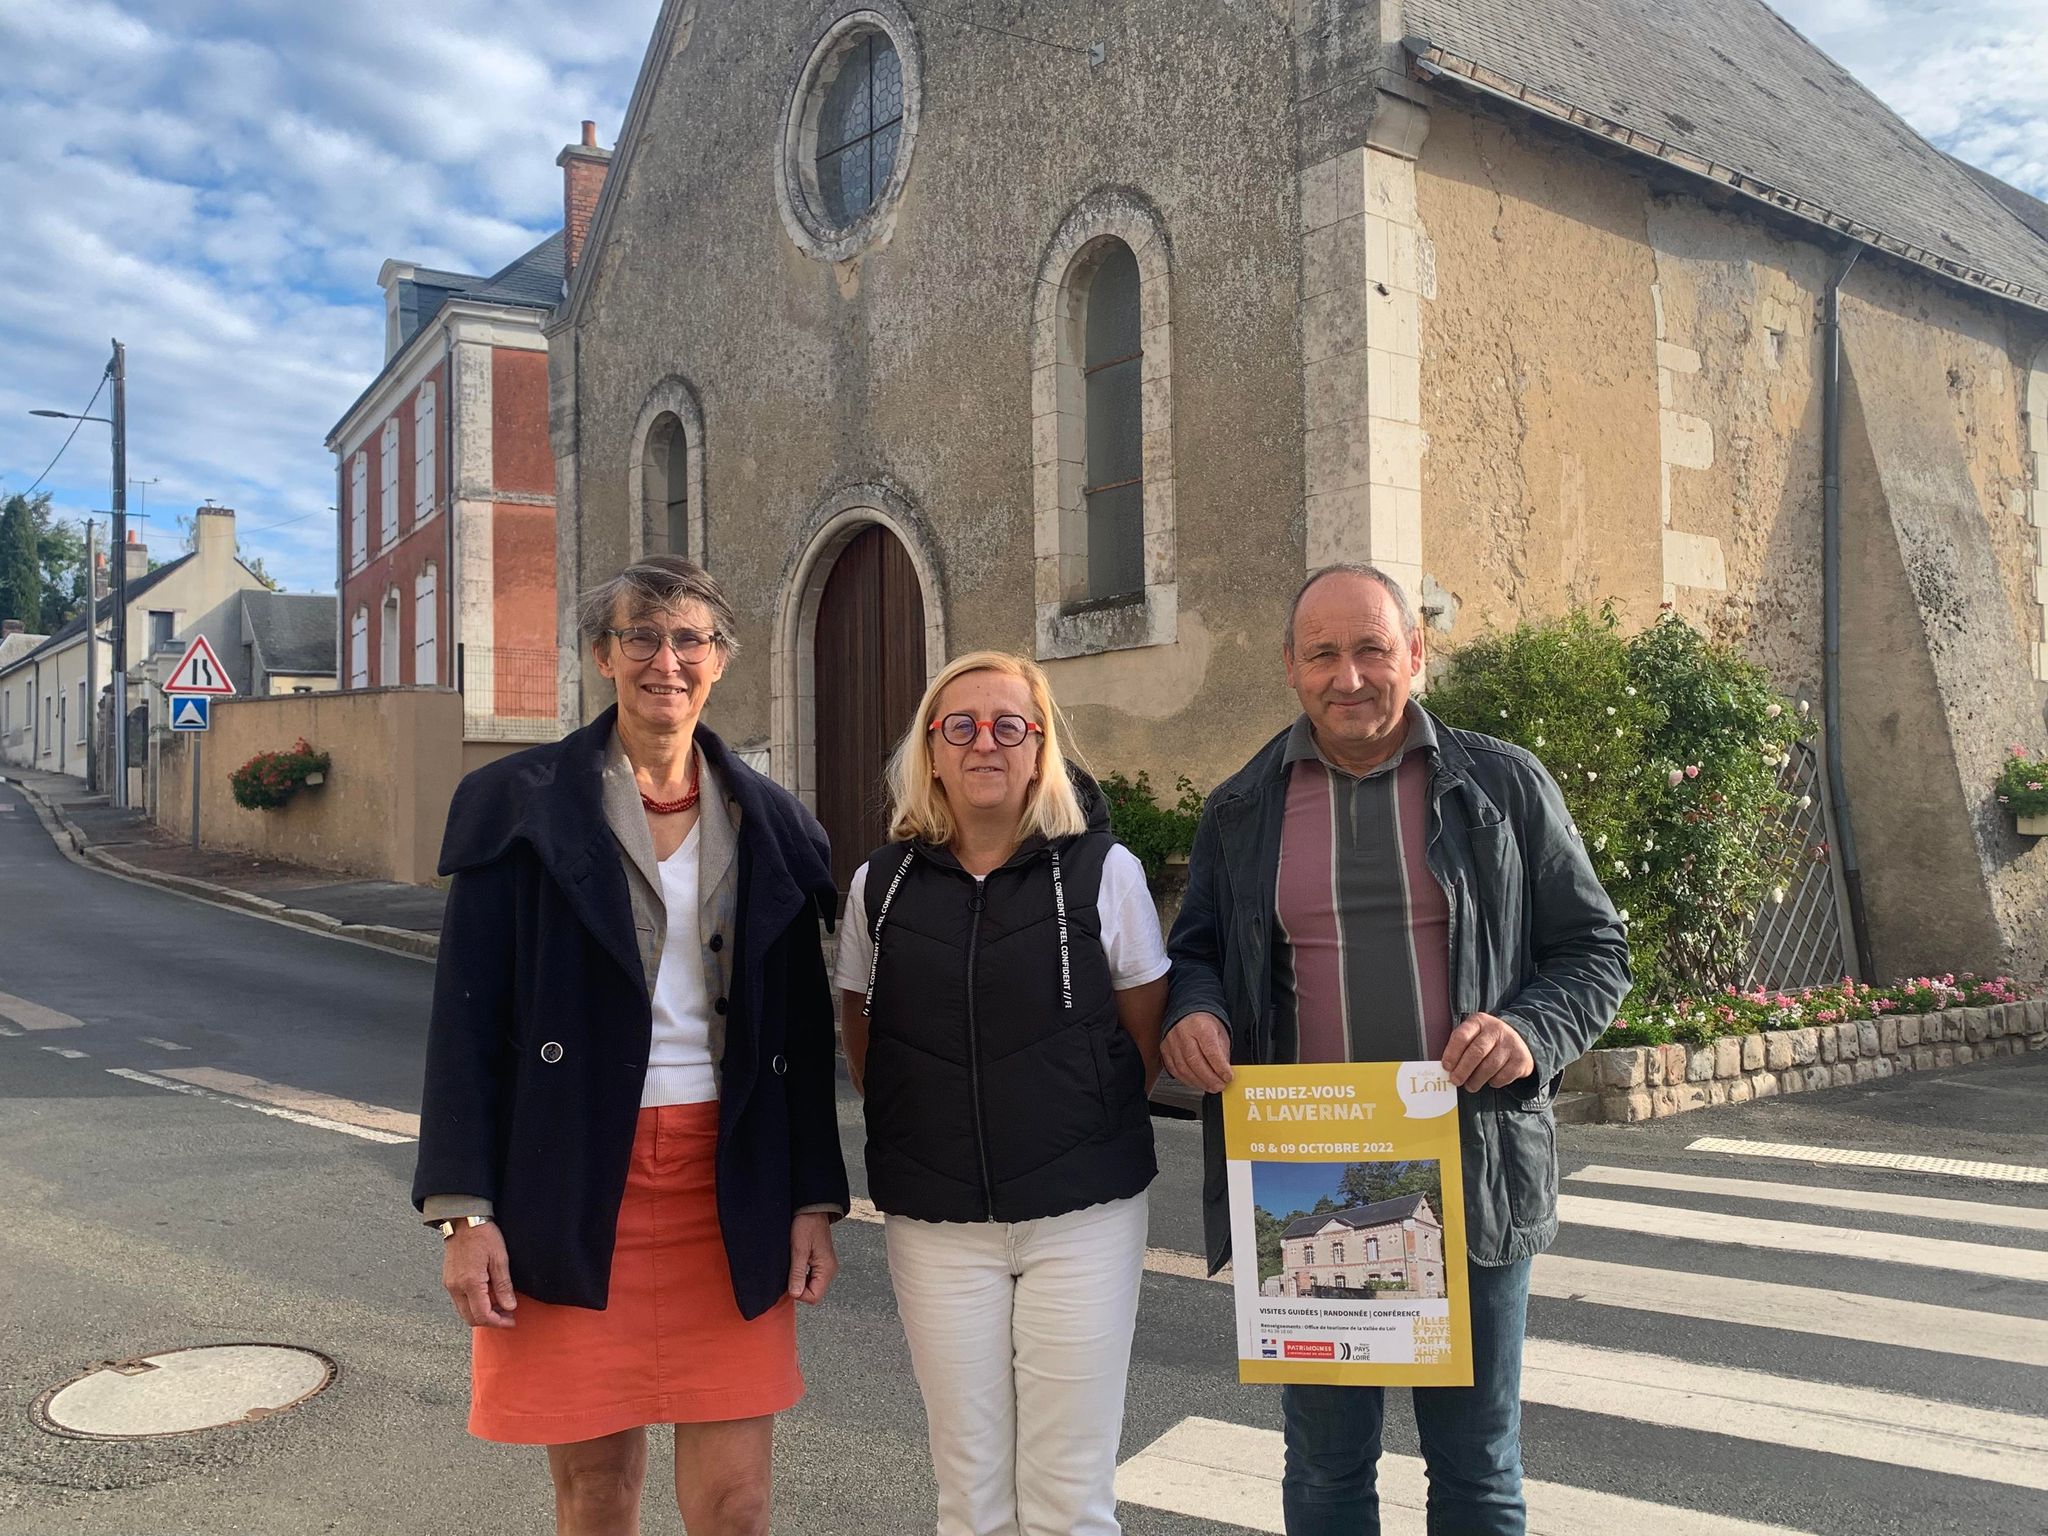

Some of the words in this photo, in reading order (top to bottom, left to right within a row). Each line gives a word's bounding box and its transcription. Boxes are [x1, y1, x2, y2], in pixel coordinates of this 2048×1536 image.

[1052, 866, 1061, 882] FEEL
[881, 874, 902, 914] CONFIDENT
[1054, 881, 1066, 917] CONFIDENT
[875, 914, 886, 932] FEEL
[1059, 926, 1068, 945] FEEL
[869, 941, 880, 986] CONFIDENT
[1061, 945, 1071, 990] CONFIDENT
[865, 986, 874, 1005] FEEL
[1244, 1085, 1356, 1100] RENDEZ-VOUS
[1247, 1102, 1262, 1121] À
[1266, 1102, 1377, 1121] LAVERNAT
[1250, 1142, 1265, 1153] 08
[1267, 1143, 1278, 1153] &
[1280, 1143, 1296, 1154] 09
[1298, 1142, 1360, 1154] OCTOBRE
[1362, 1142, 1394, 1153] 2022
[1287, 1308, 1319, 1316] GUIDÉES
[1323, 1309, 1368, 1317] RANDONNÉE
